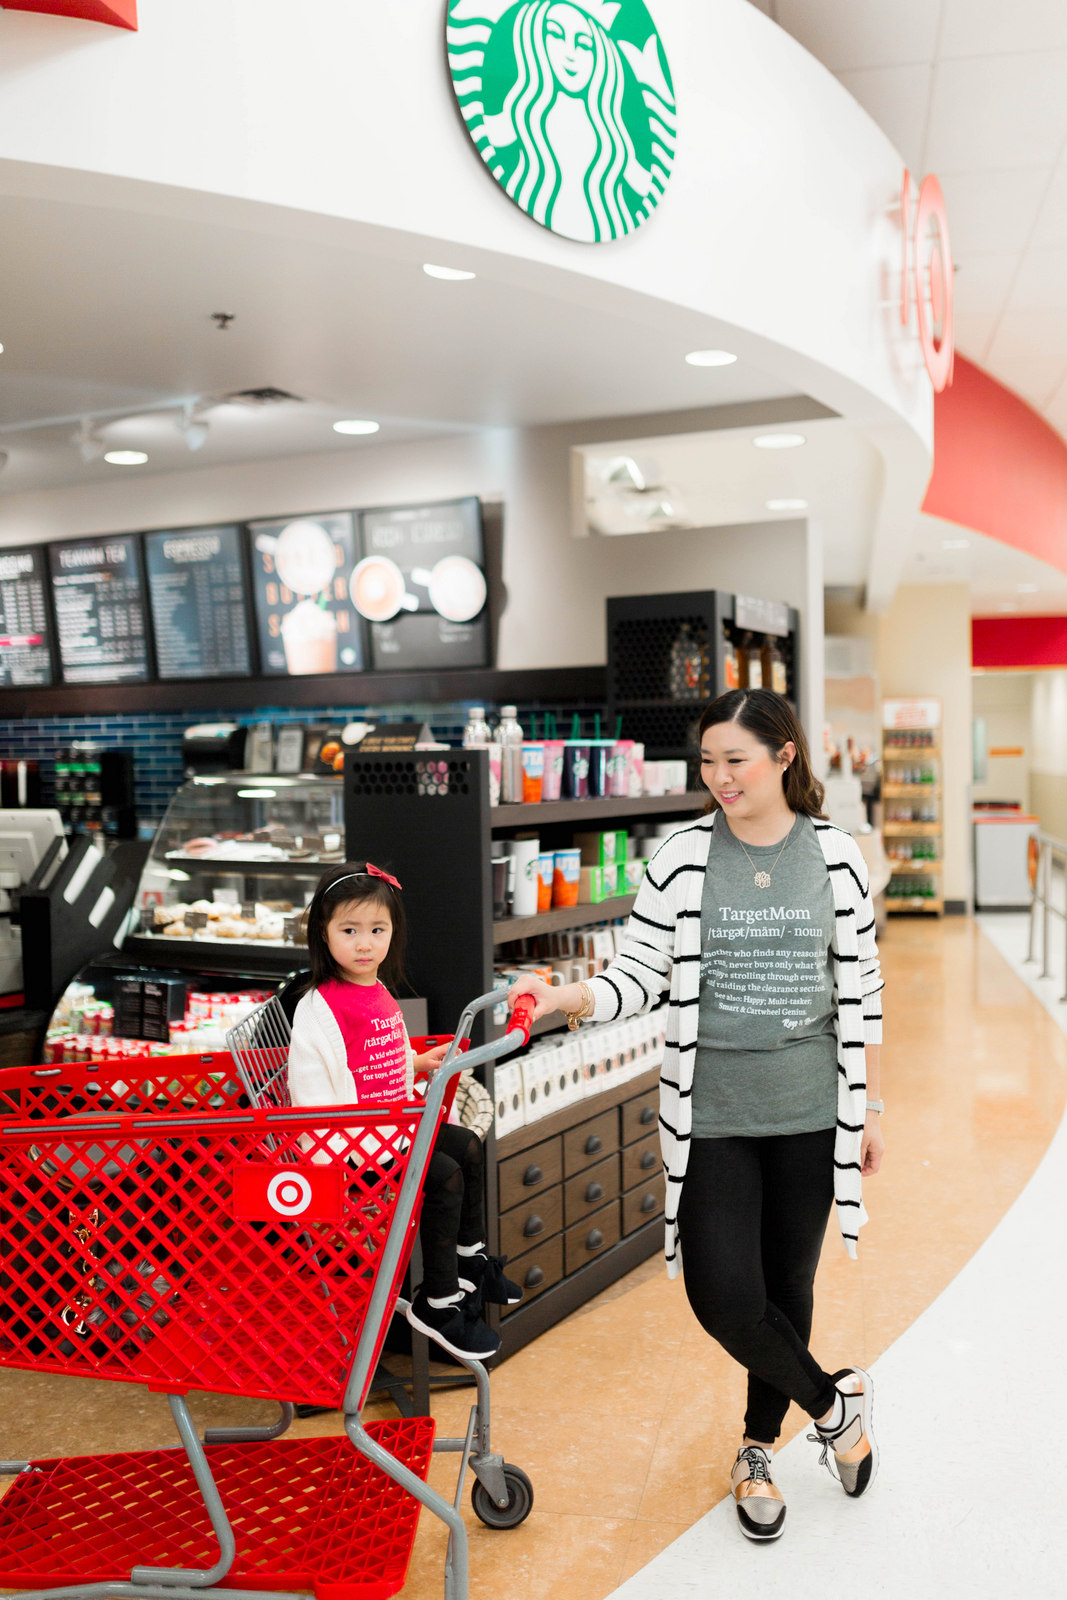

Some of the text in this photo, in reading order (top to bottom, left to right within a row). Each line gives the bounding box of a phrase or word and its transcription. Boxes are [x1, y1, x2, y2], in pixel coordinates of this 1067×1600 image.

[719, 907, 811, 924] TargetMom
[794, 927, 822, 937] noun
[704, 949, 732, 958] mother
[734, 950, 752, 958] who
[752, 949, 774, 957] finds
[776, 950, 791, 960] any
[754, 961, 774, 970] buys
[774, 962, 793, 970] only
[730, 972, 766, 982] strolling
[767, 972, 800, 982] through
[716, 982, 746, 992] raiding
[747, 983, 761, 992] the
[762, 984, 798, 992] clearance
[726, 994, 742, 1002] also:
[744, 996, 767, 1006] Happy;
[718, 1002, 740, 1012] Smart
[746, 1006, 780, 1015] Cartwheel
[370, 1054, 376, 1062] A
[375, 1052, 386, 1060] kid
[382, 1059, 394, 1068] with
[363, 1074, 374, 1082] for
[374, 1072, 388, 1080] toys,
